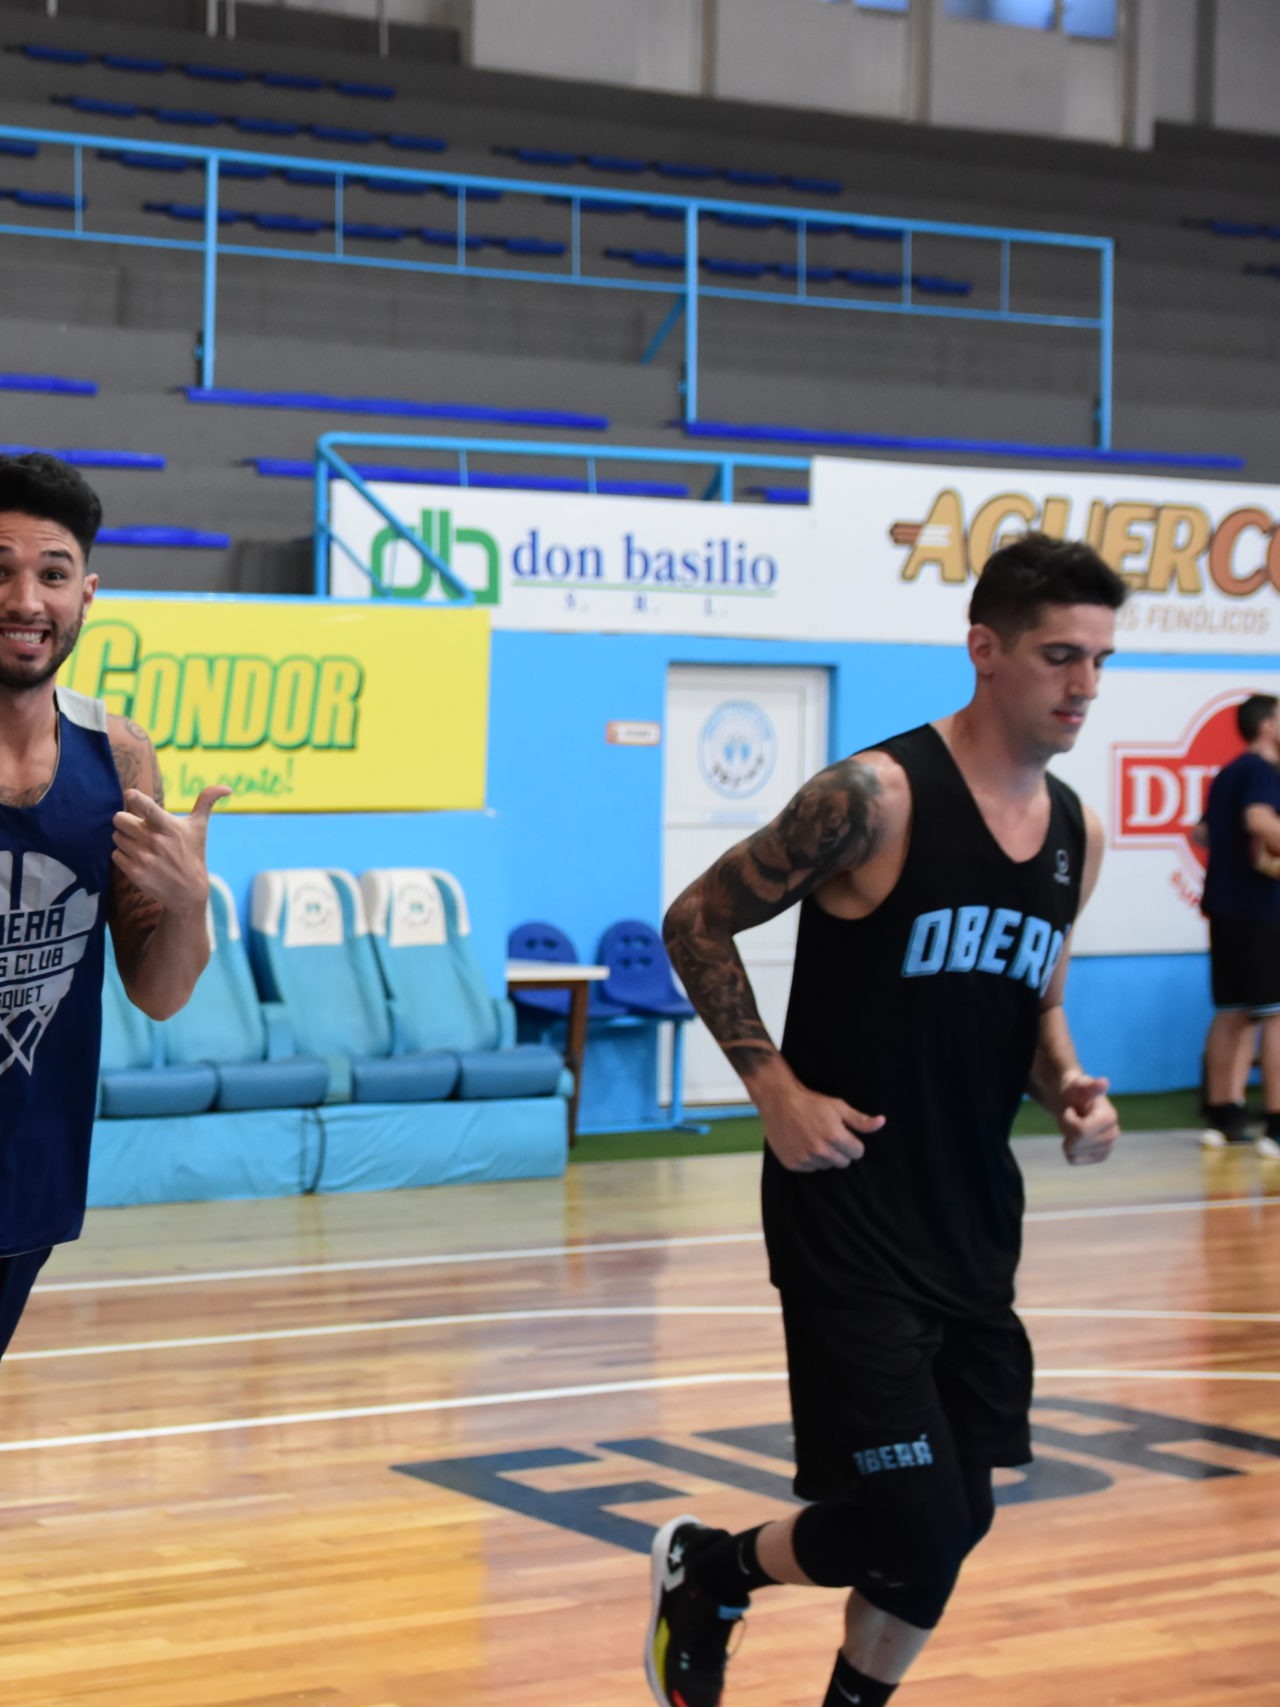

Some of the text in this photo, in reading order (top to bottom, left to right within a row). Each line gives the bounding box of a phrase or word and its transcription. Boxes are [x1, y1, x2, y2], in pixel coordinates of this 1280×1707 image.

[511, 528, 779, 589] don basilio
[14, 946, 64, 976] CLUB
